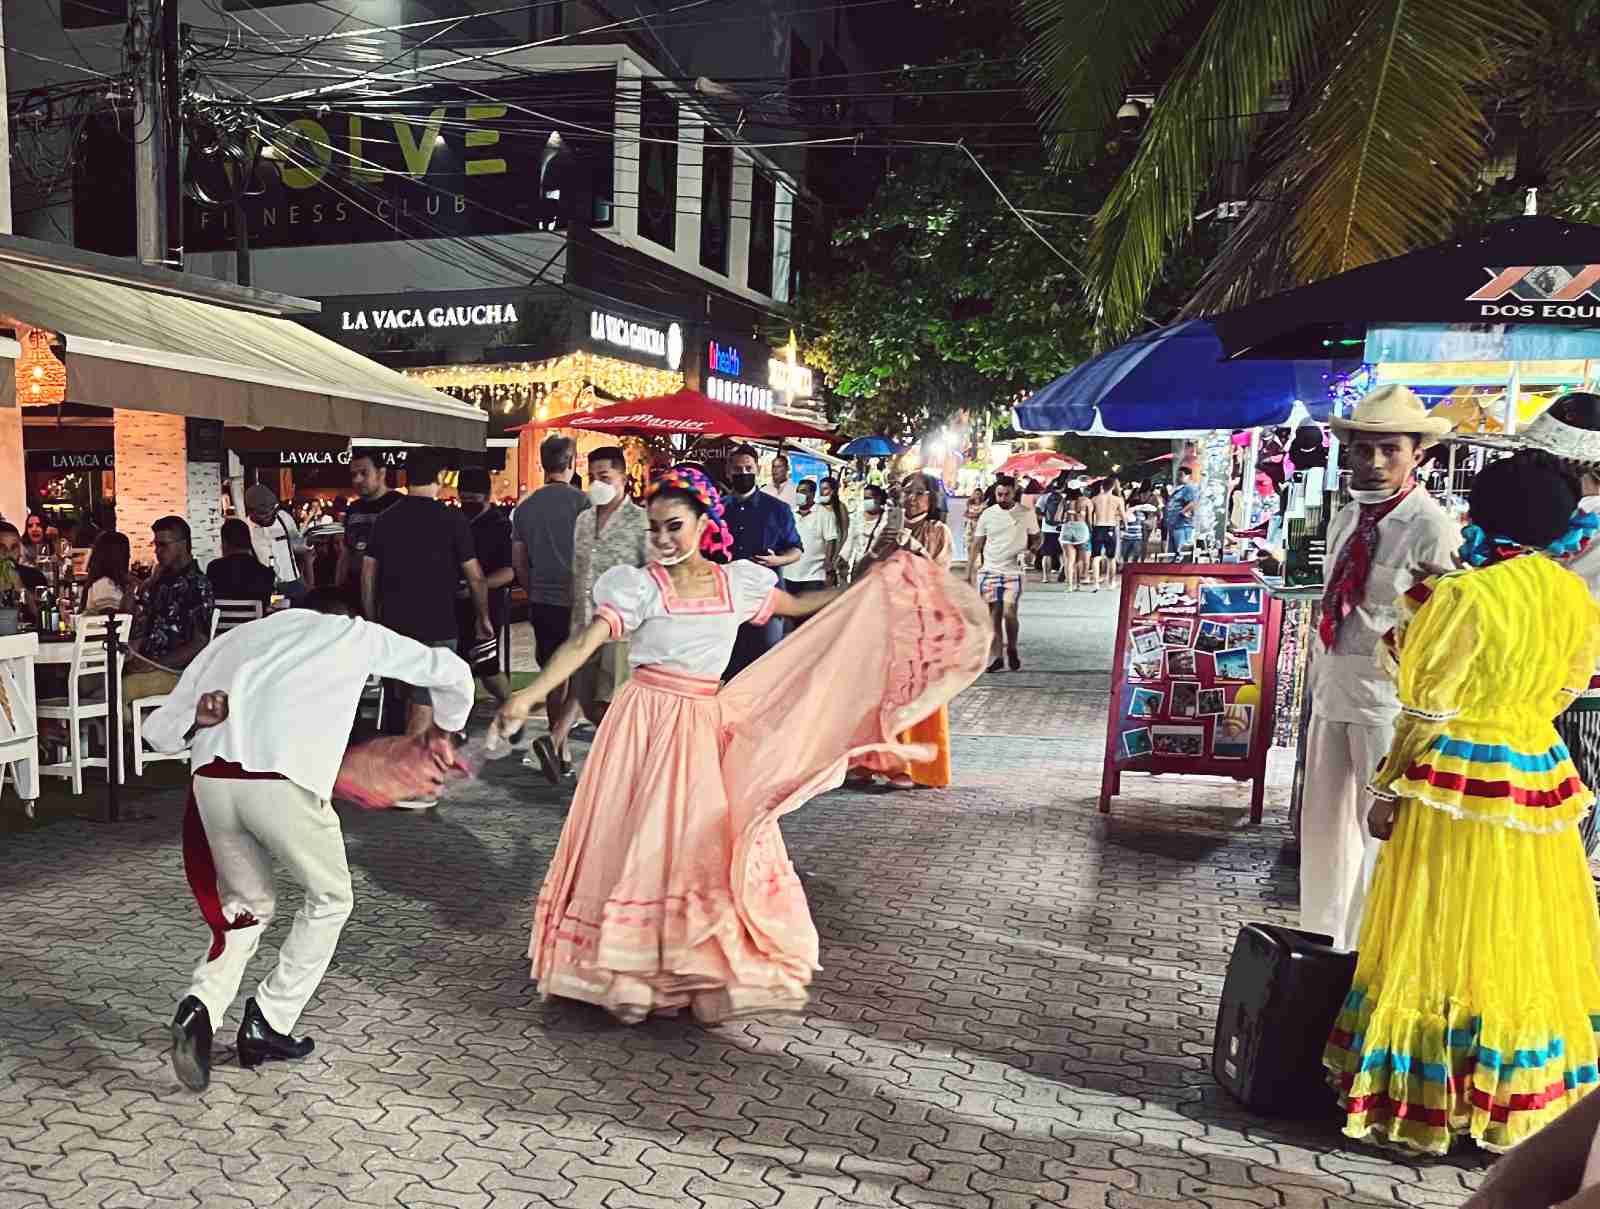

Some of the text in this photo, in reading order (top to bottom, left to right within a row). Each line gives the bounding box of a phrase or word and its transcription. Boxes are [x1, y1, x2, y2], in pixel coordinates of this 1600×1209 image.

[201, 195, 466, 228] FINESS CLUB
[342, 303, 518, 329] LA VACA GAUCHA
[1481, 304, 1535, 317] DOS
[591, 311, 606, 340] LA
[606, 314, 630, 347] VACA
[52, 455, 68, 468] LA
[68, 453, 100, 467] VACA
[280, 451, 298, 464] LA
[298, 451, 333, 464] VACA
